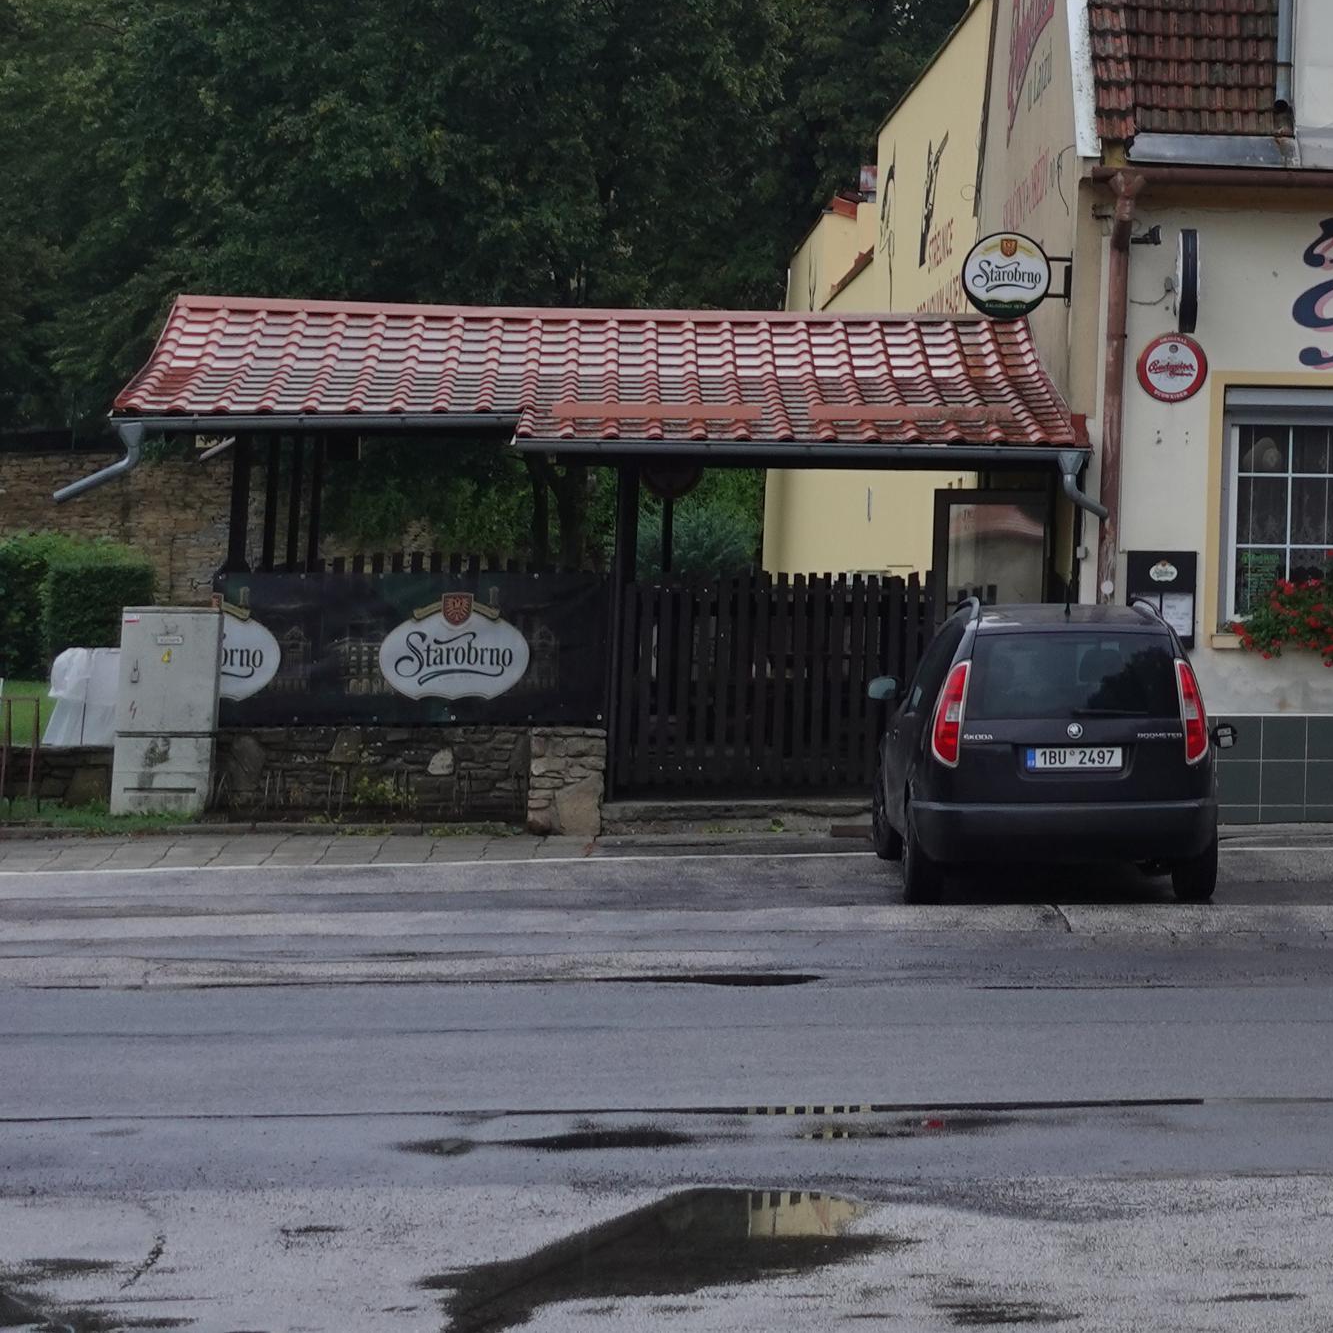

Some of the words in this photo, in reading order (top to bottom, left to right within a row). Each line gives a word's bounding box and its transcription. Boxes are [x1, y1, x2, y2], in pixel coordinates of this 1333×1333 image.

[972, 260, 1042, 291] Starobrno
[394, 631, 513, 681] Starobrno
[1040, 750, 1067, 765] 1BU
[1079, 750, 1115, 765] 2497
